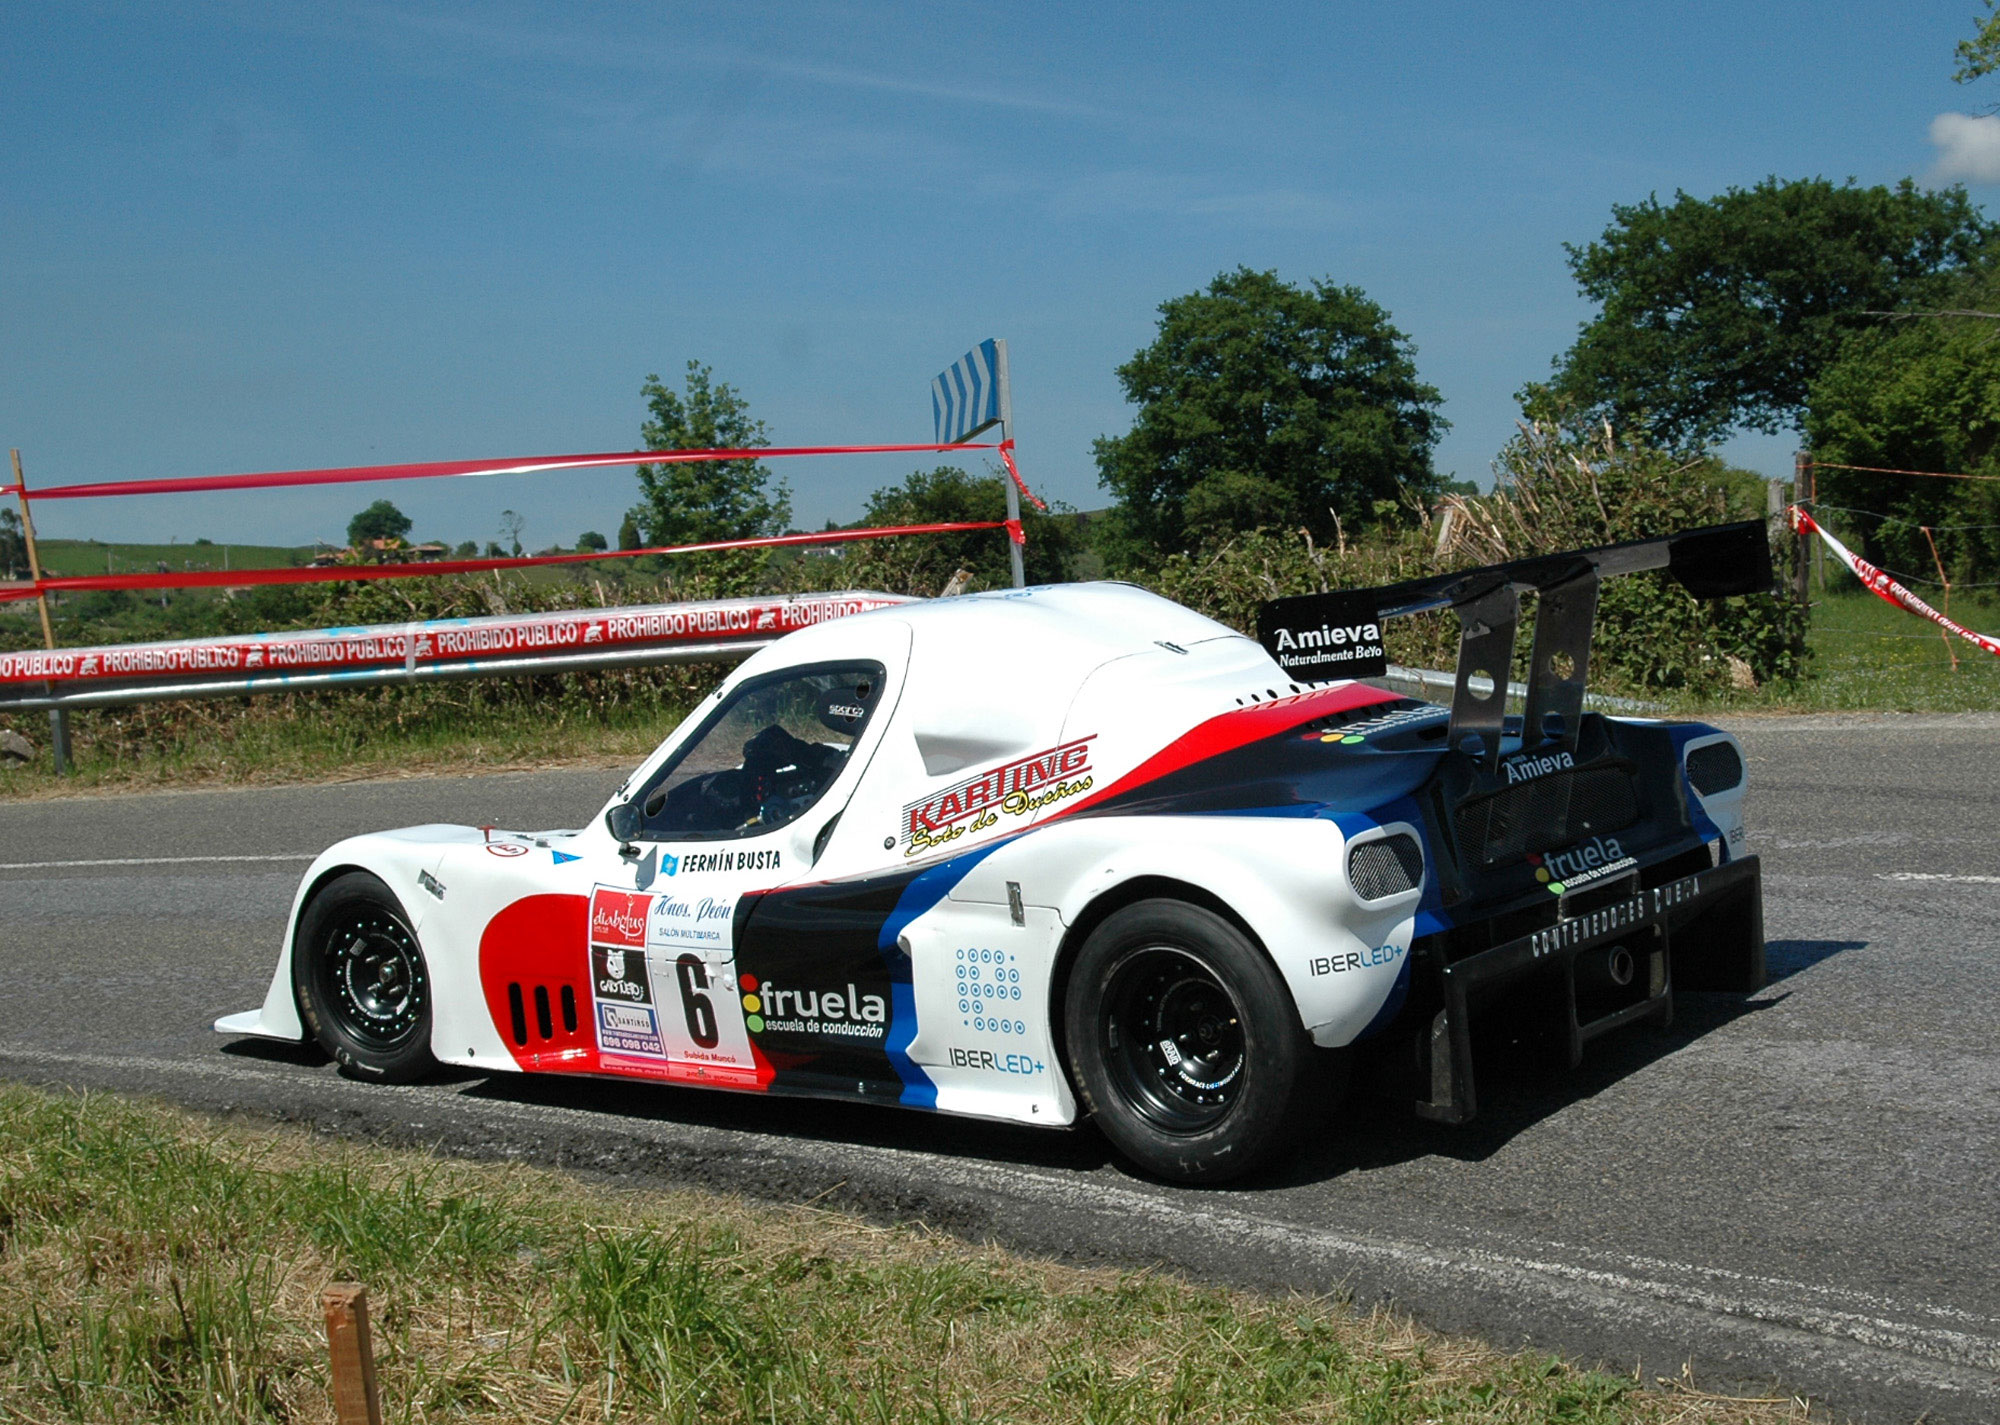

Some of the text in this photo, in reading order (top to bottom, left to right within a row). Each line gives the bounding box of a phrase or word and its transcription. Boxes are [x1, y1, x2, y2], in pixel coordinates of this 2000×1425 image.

[608, 609, 750, 639] PROHIBIDO PUBLICO
[781, 602, 857, 626] PROHIBIDO
[268, 636, 407, 665] PROHIBIDO PUBLICO
[437, 623, 577, 653] PROHIBIDO PUBLICO
[1274, 623, 1379, 652] Amieva
[15, 655, 74, 677] PUBLICO
[103, 647, 239, 673] PROHIBIDO PUBLICO
[1280, 650, 1354, 667] Naturalmente
[1501, 752, 1575, 784] Amieva
[909, 744, 1089, 832] KARTING
[904, 775, 1093, 857] Soto de Dueñas
[681, 849, 781, 873] FERMÍN BUSTA
[1544, 836, 1625, 880] fruela
[696, 897, 732, 923] Peón
[676, 952, 719, 1049] 6
[760, 981, 886, 1022] fruela
[765, 1019, 883, 1039] escuela de conducción
[641, 1041, 661, 1052] 042
[684, 1050, 709, 1060] Subida
